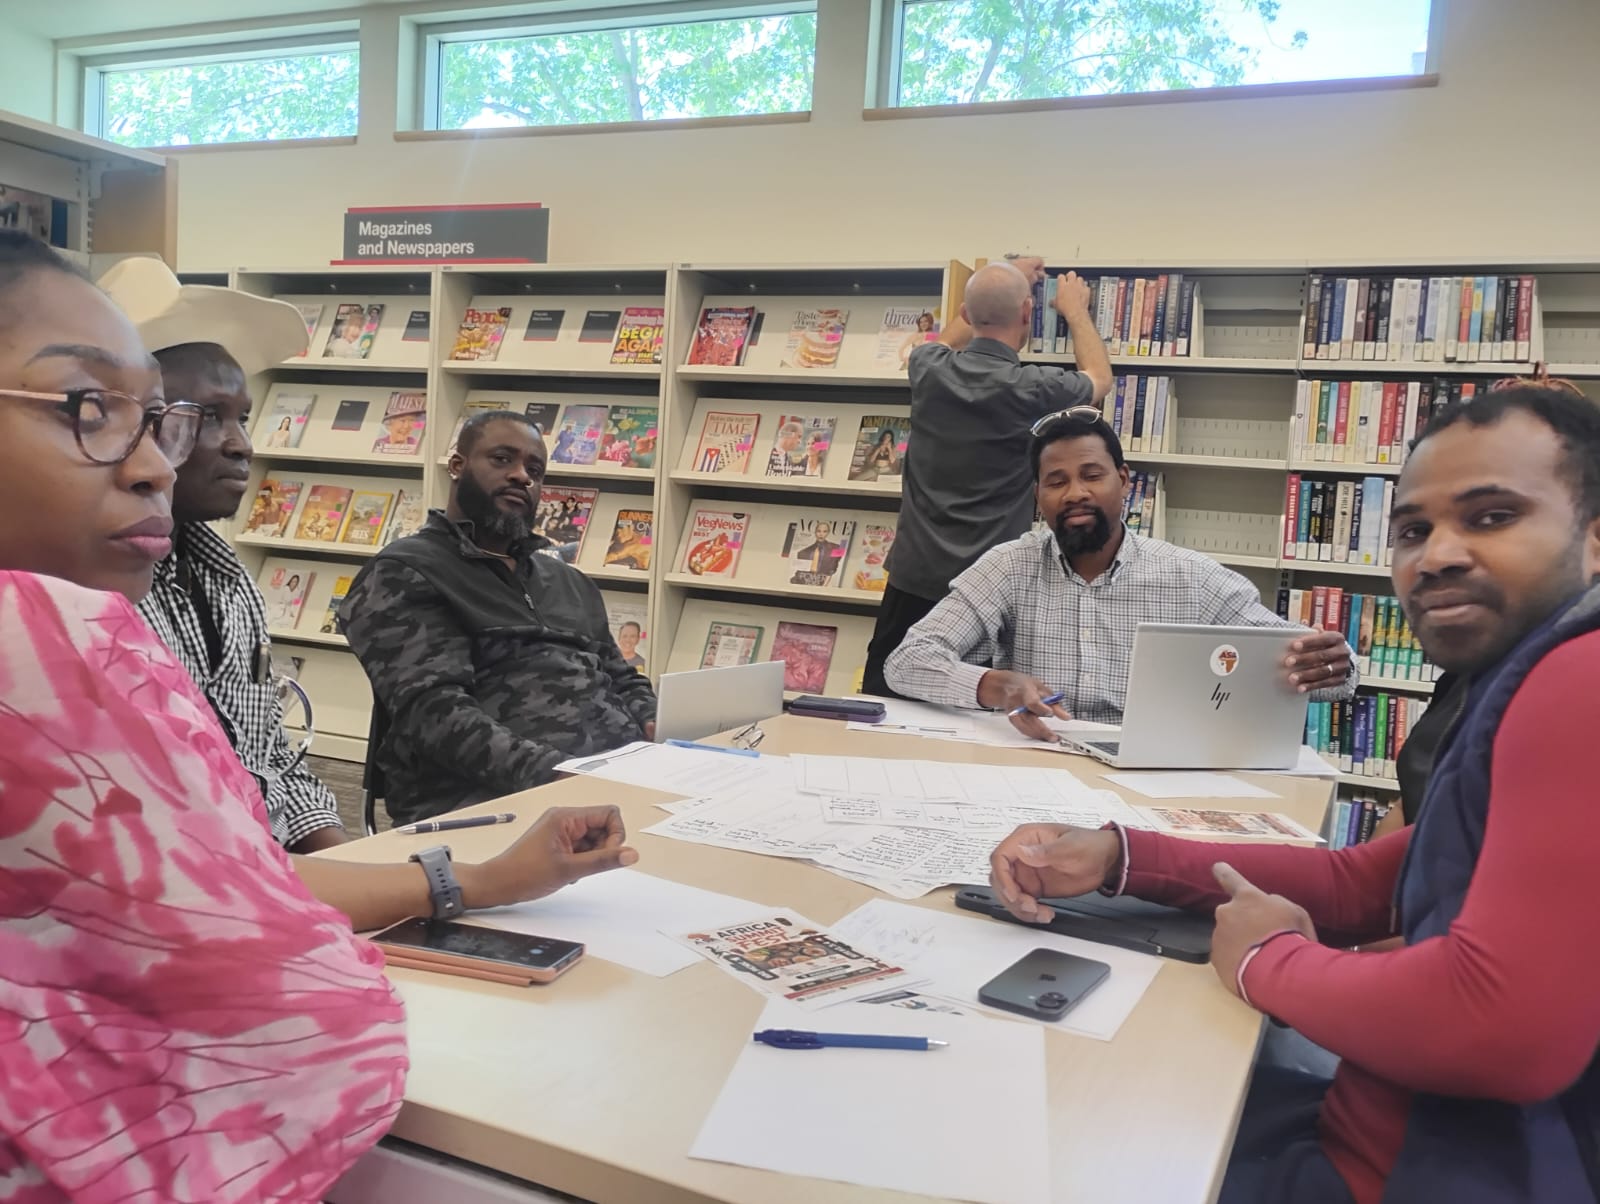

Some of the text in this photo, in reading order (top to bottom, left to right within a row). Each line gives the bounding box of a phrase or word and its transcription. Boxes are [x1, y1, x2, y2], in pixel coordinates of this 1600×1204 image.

[359, 221, 432, 238] Magazines
[358, 239, 475, 258] and Newspapers
[711, 422, 752, 435] TIME
[698, 516, 743, 531] VegNews
[800, 519, 853, 536] VOUE
[1211, 682, 1231, 710] hp
[716, 920, 778, 940] AFRICA
[724, 926, 785, 944] SUMMIT
[736, 933, 790, 951] FEST
